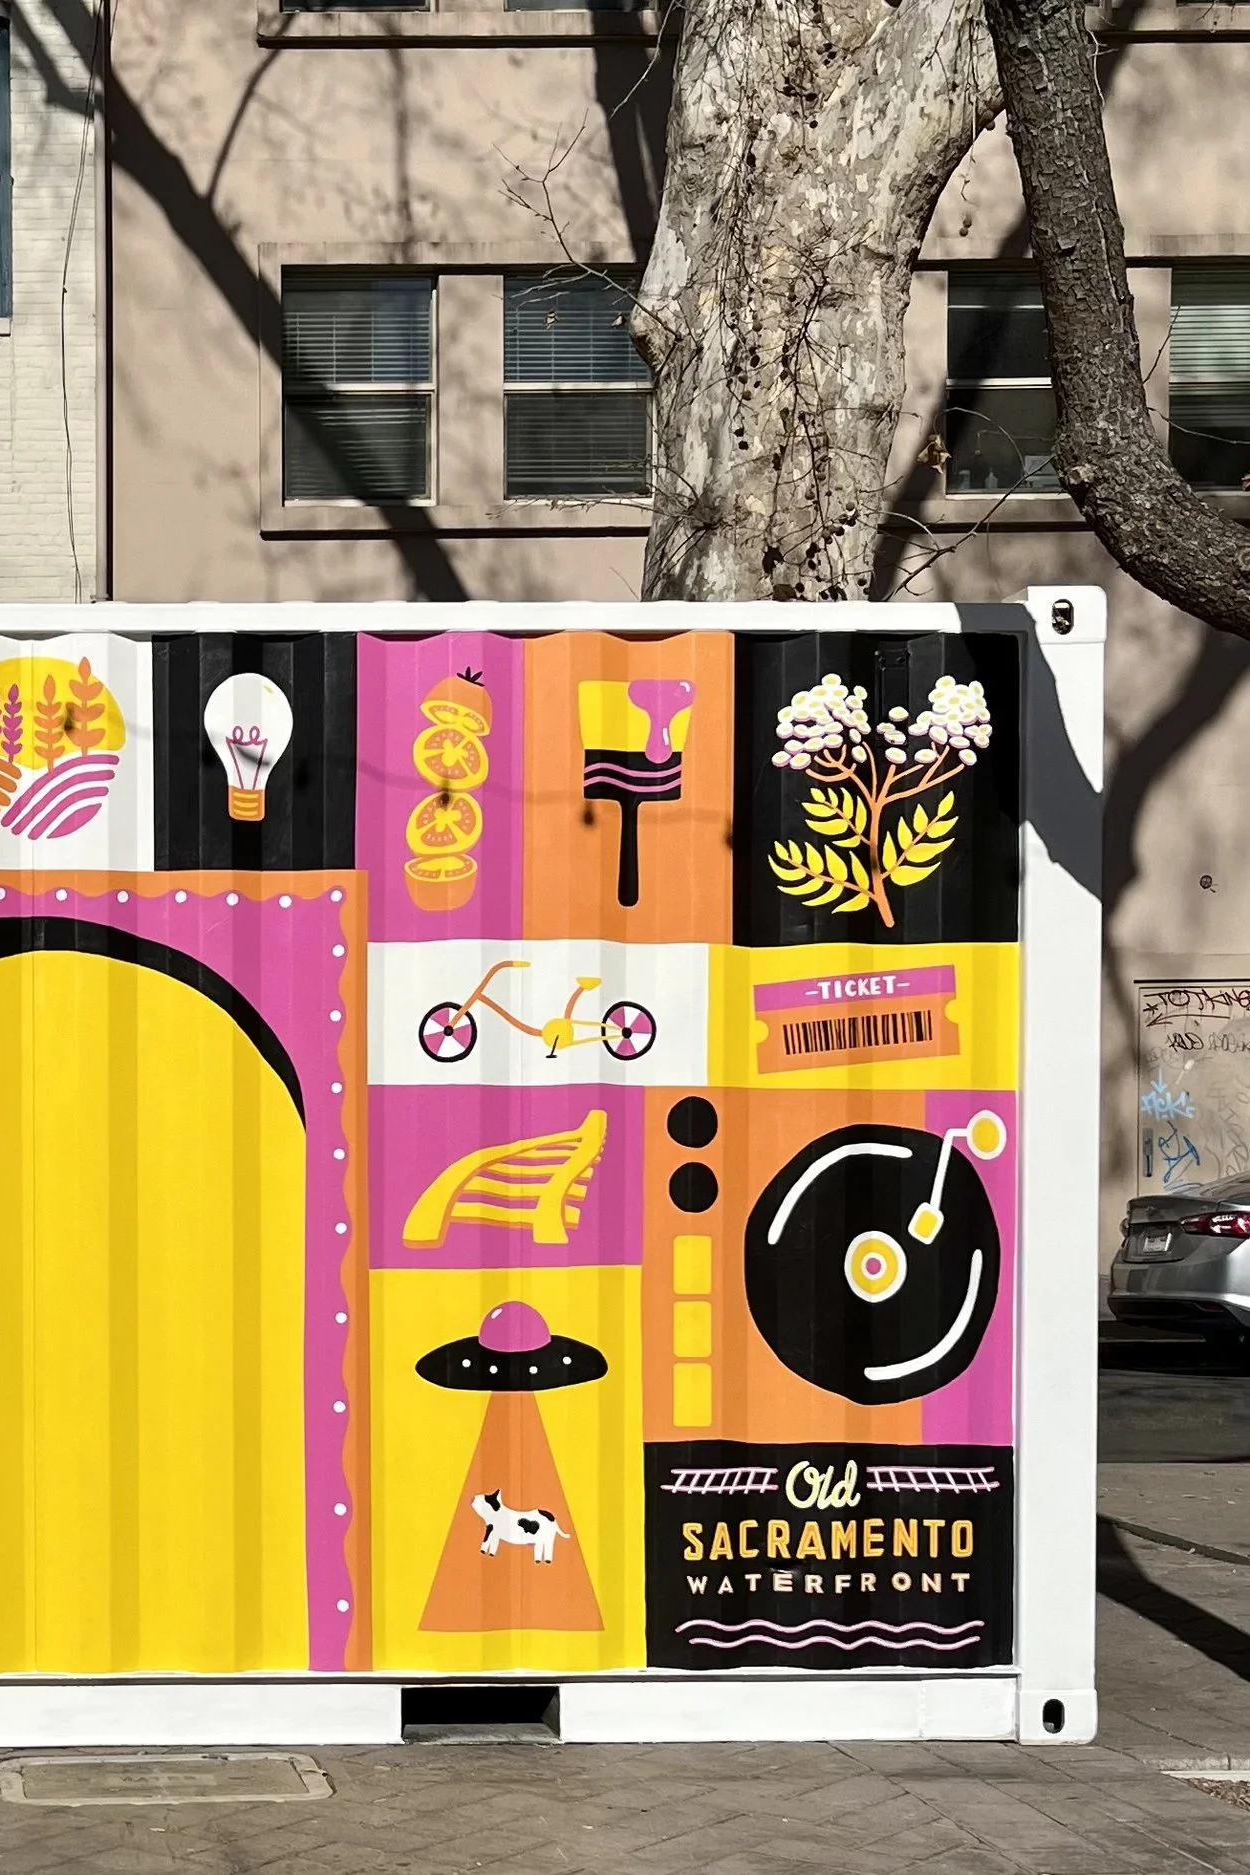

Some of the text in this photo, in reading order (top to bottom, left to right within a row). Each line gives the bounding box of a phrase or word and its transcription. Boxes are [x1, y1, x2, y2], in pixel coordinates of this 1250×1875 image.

[785, 1460, 860, 1510] Old
[682, 1518, 974, 1561] SACRAMENTO
[687, 1571, 971, 1595] WATERFRONT
